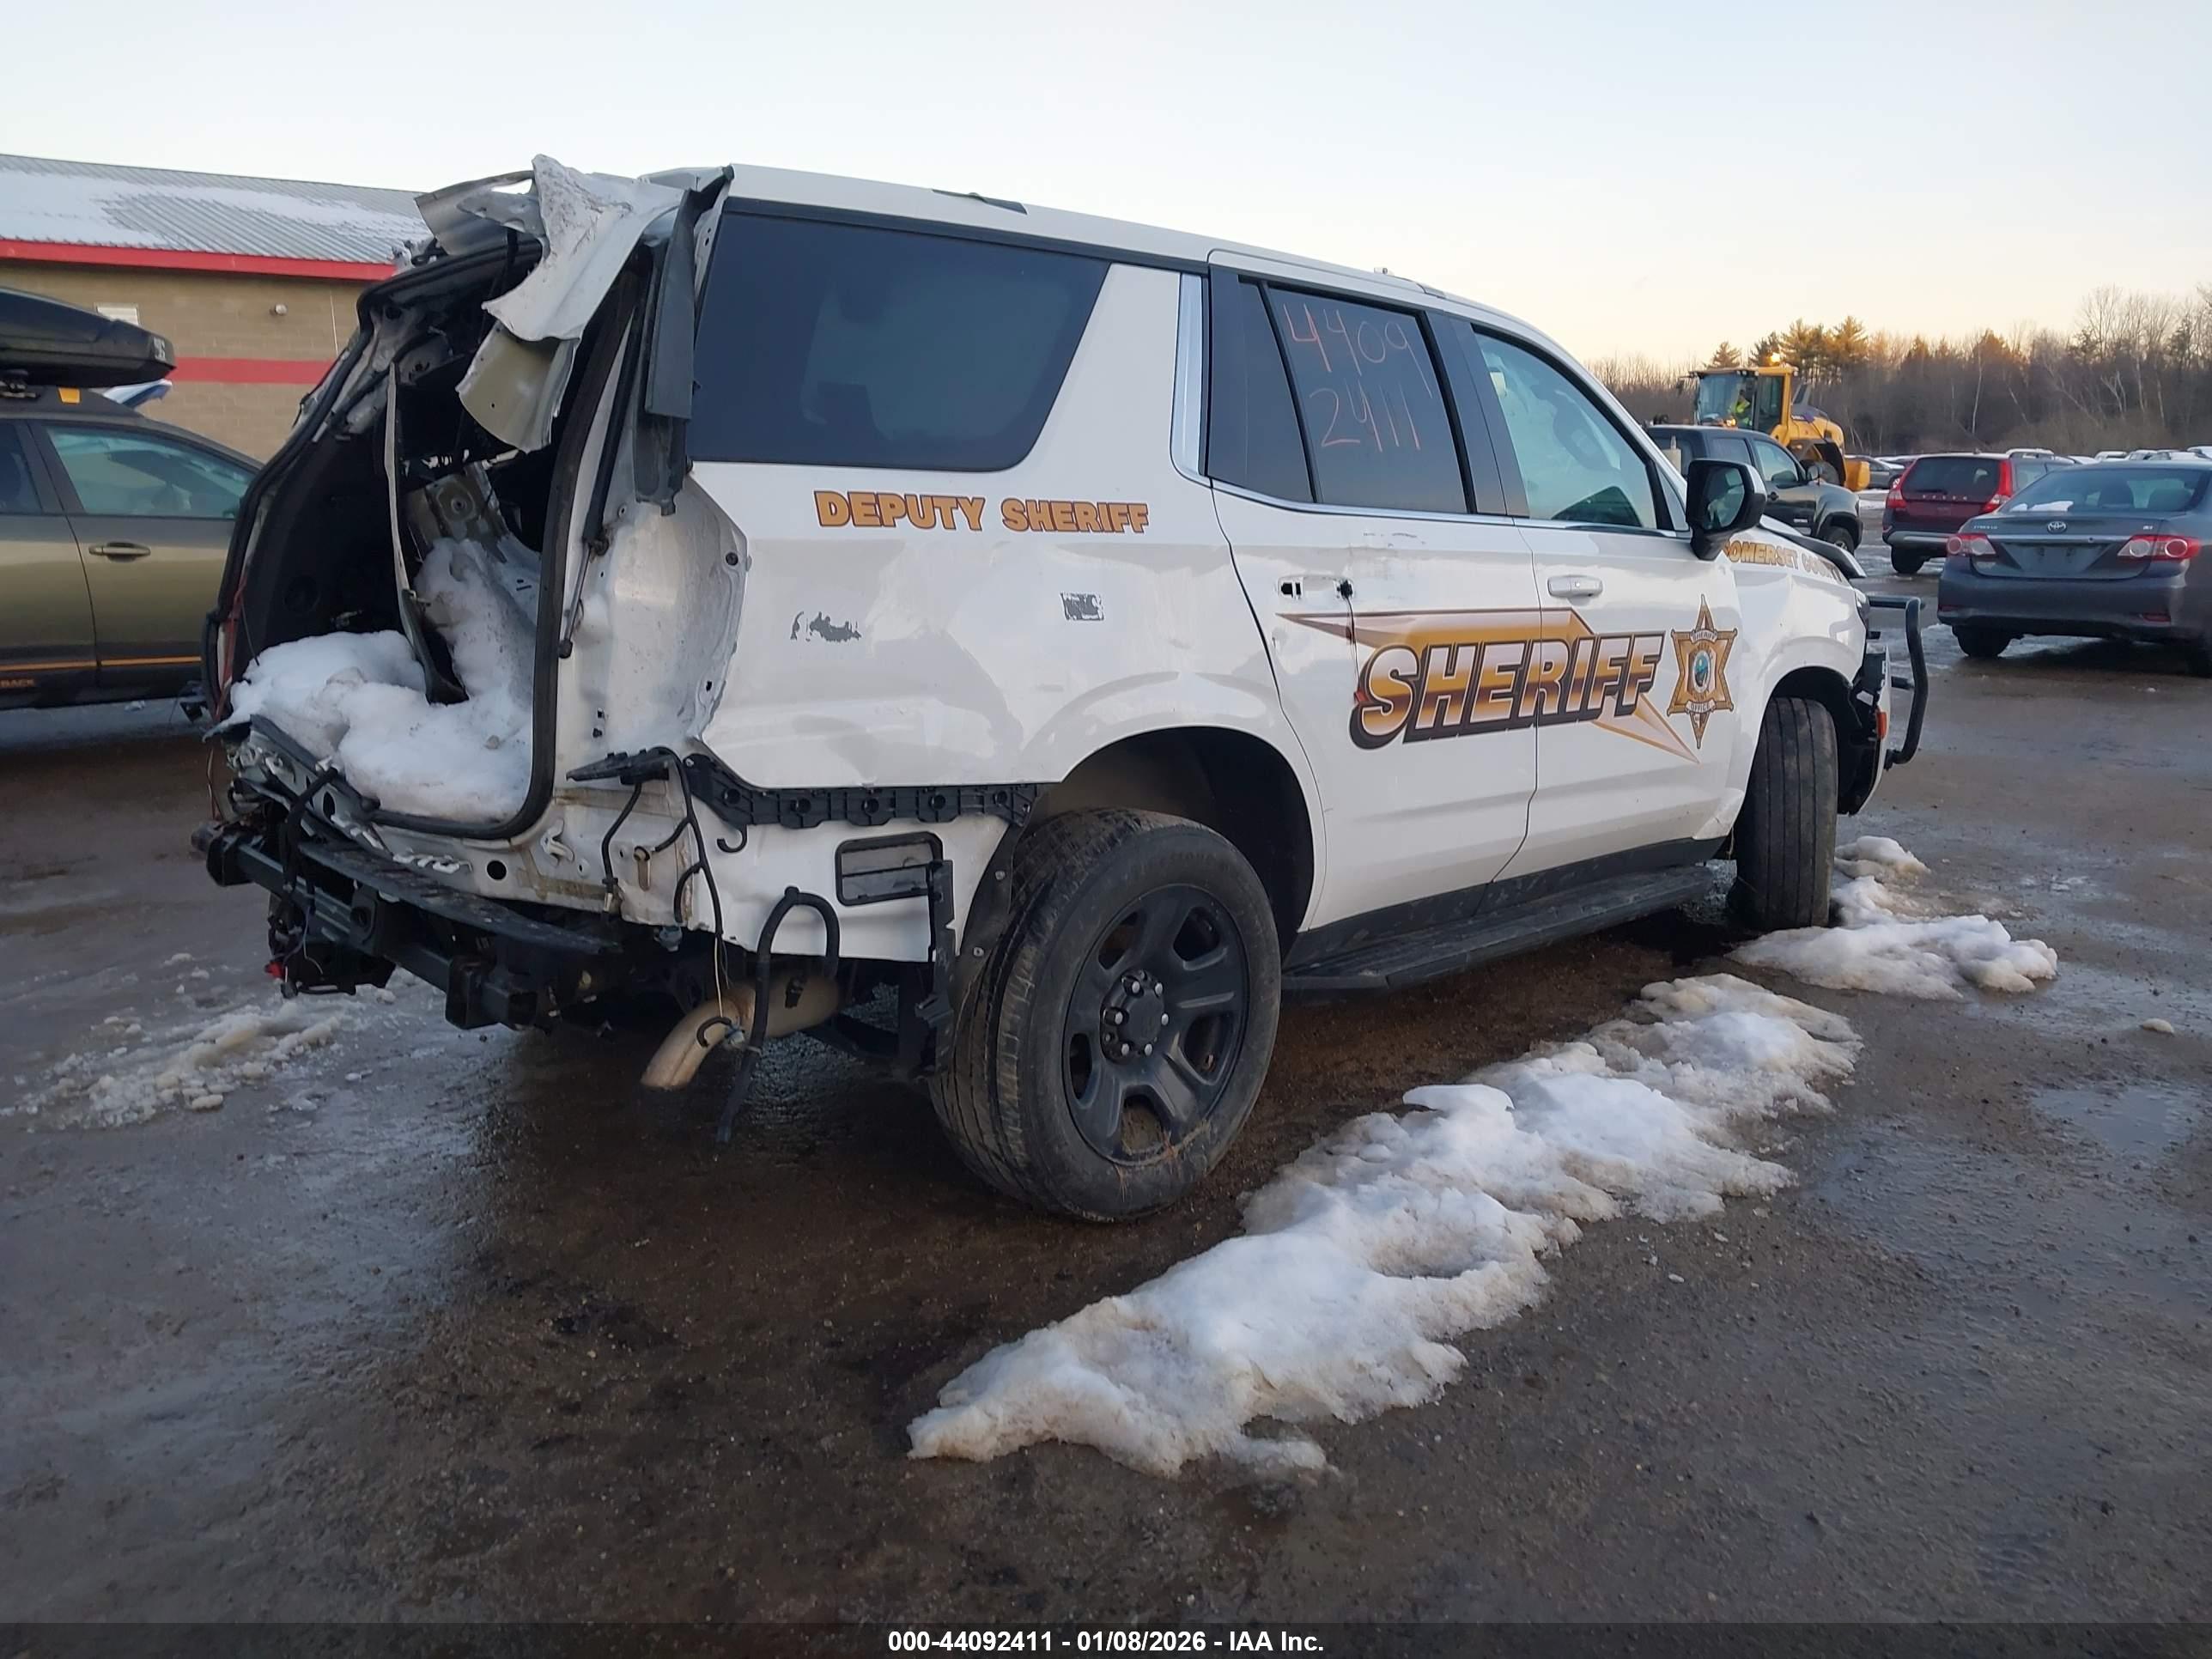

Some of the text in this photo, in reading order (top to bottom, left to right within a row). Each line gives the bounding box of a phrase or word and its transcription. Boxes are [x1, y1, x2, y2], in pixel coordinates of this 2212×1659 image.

[1283, 303, 1433, 398] 4409
[1309, 379, 1421, 453] 2411
[813, 489, 1149, 533] DEPUTY SHERIFF
[1350, 630, 1665, 750] SHERIFF
